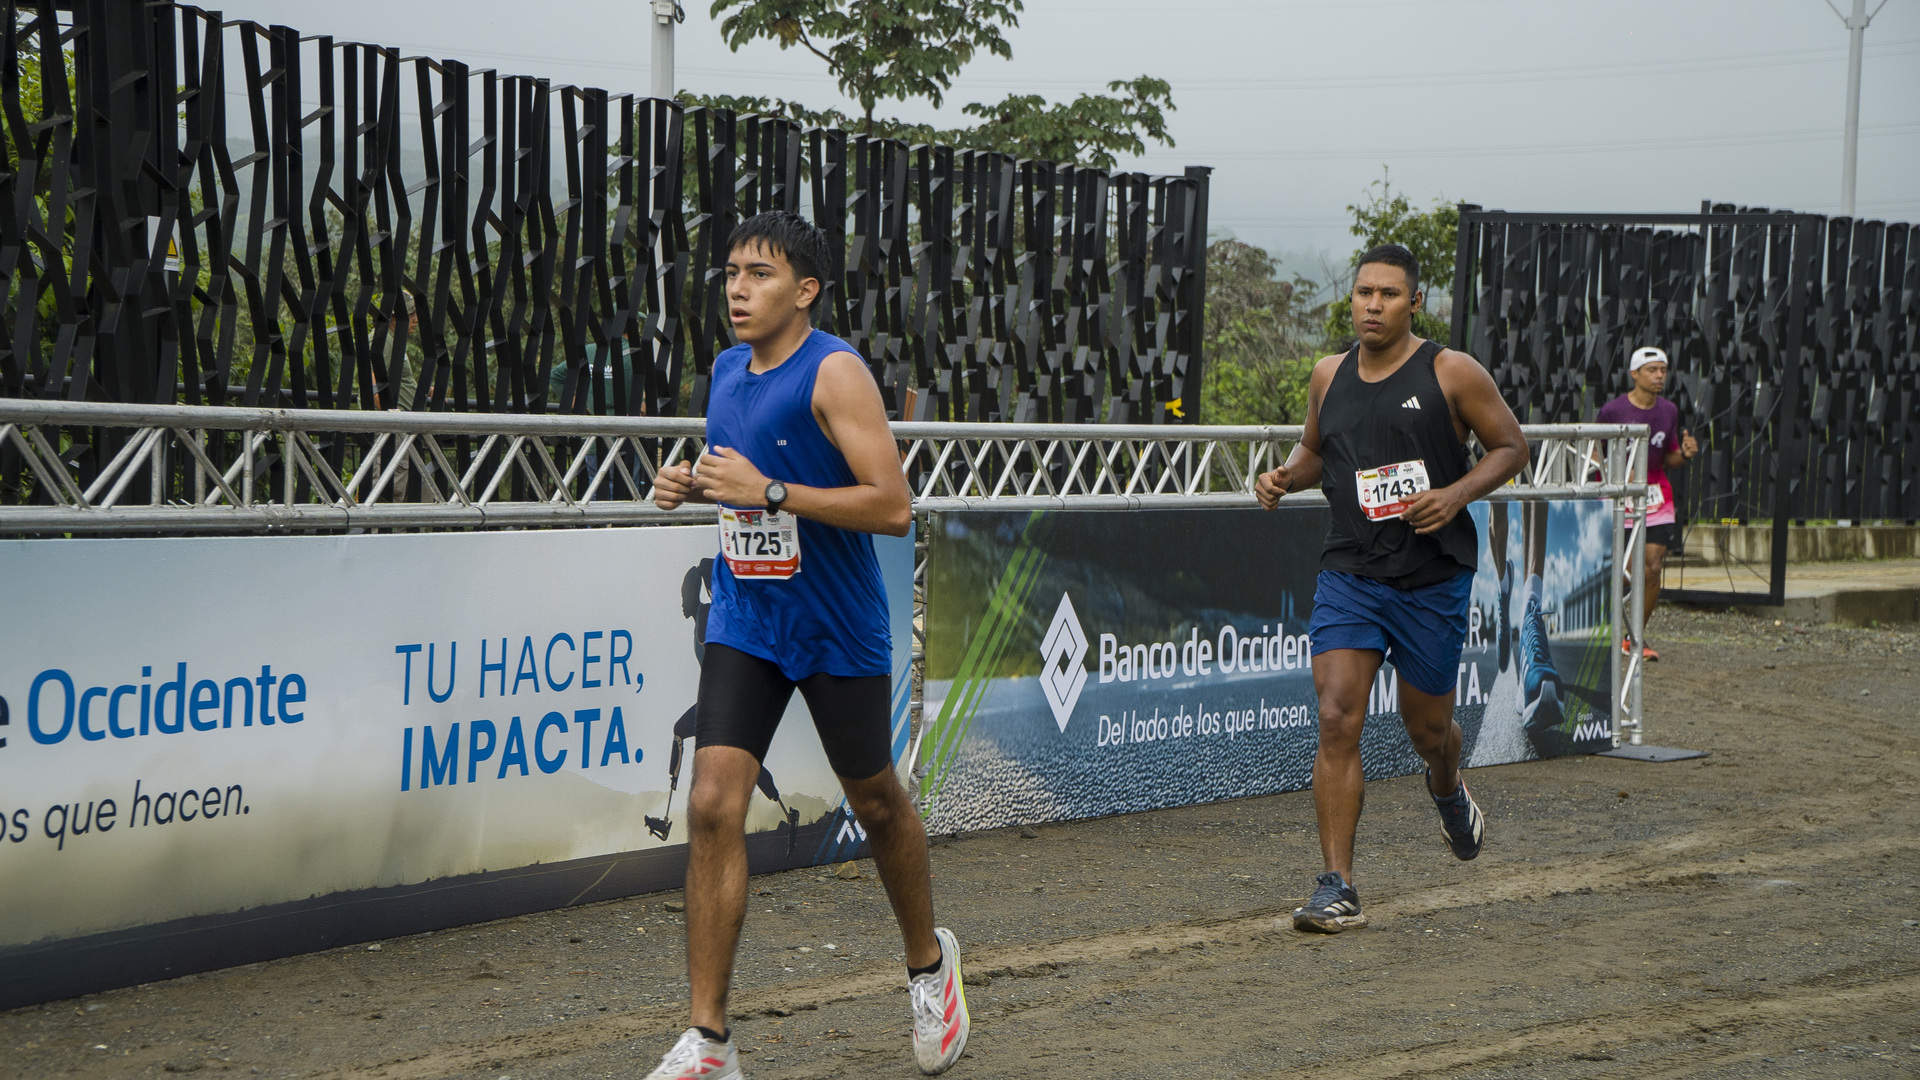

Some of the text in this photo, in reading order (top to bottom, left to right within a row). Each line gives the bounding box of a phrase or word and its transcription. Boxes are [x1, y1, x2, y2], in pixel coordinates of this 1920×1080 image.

[1372, 478, 1417, 503] 1743
[731, 530, 782, 556] 1725
[395, 629, 644, 706] TU HACER,
[1099, 622, 1313, 684] Banco de Occiden
[27, 661, 307, 745] Occidente
[1097, 698, 1311, 746] Del lado de los que hacen.
[1573, 719, 1612, 743] AVAL
[401, 706, 644, 792] IMPACTA.
[44, 797, 117, 851] que
[129, 779, 250, 828] hacen.
